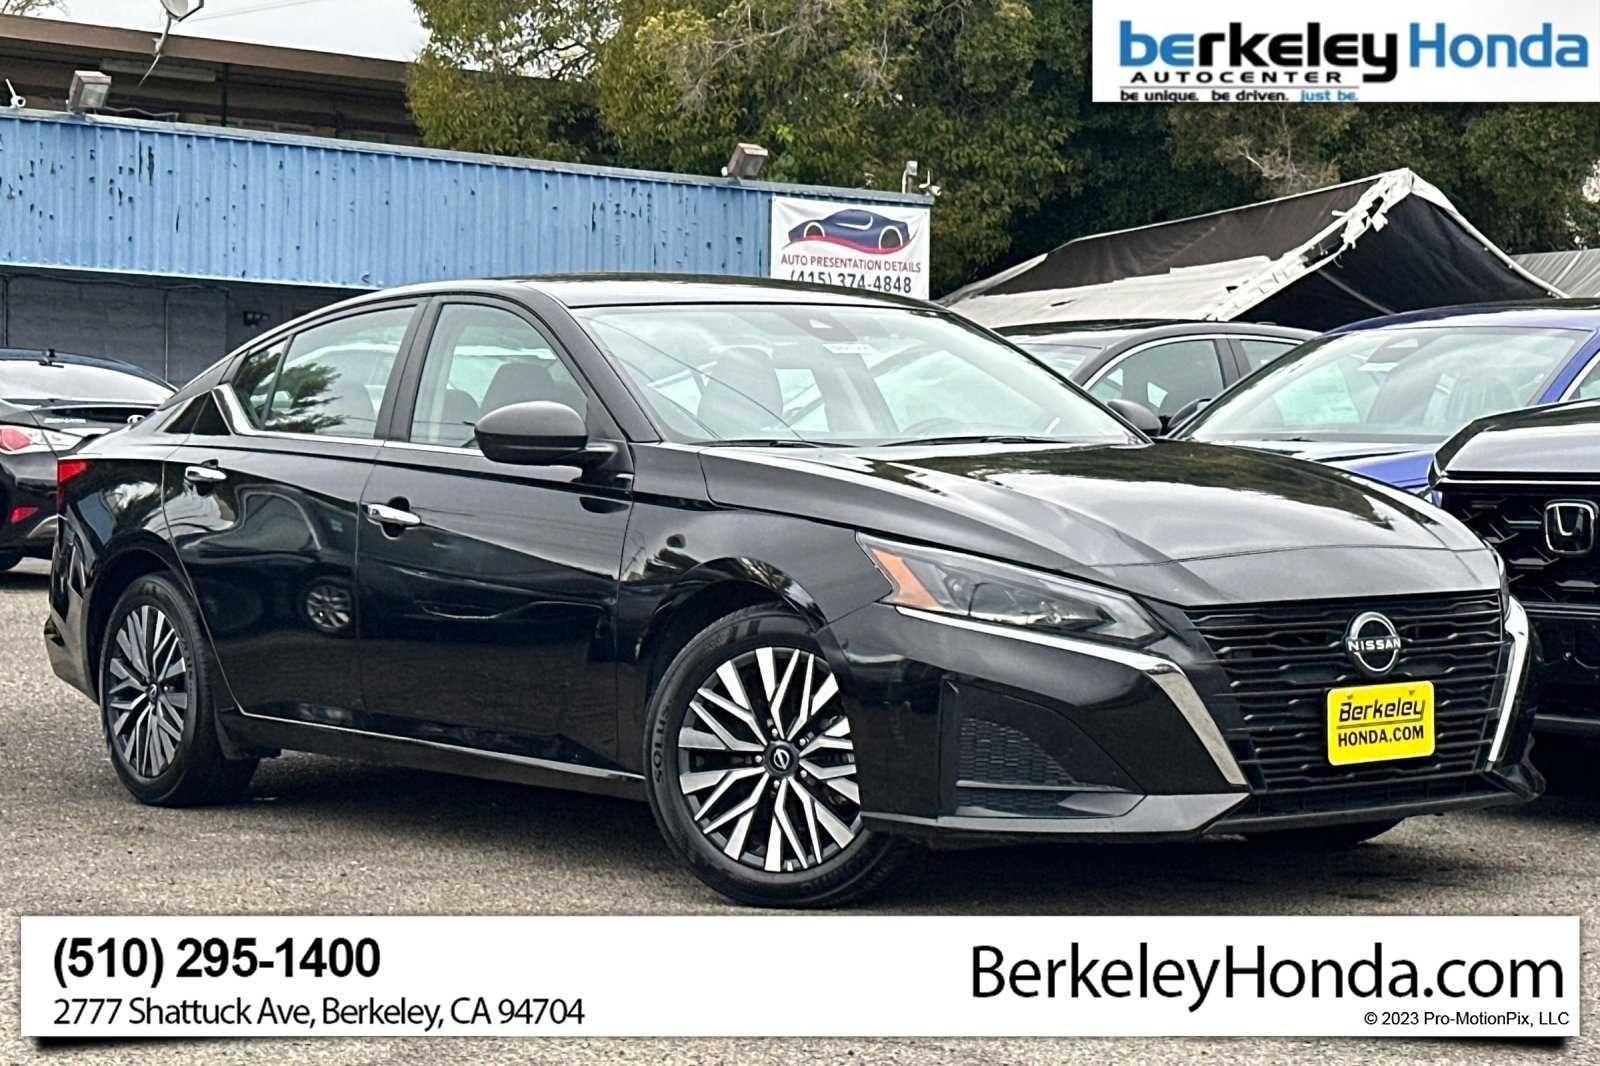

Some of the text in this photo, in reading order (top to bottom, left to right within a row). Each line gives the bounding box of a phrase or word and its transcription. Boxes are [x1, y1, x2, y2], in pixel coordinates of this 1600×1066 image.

[781, 254, 921, 273] AUTO PRESENTATION DETAILS
[837, 273, 912, 293] 374-4848
[1348, 639, 1401, 651] NISSAN
[1338, 697, 1426, 722] Berkeley
[1338, 725, 1424, 747] HONDA.COM
